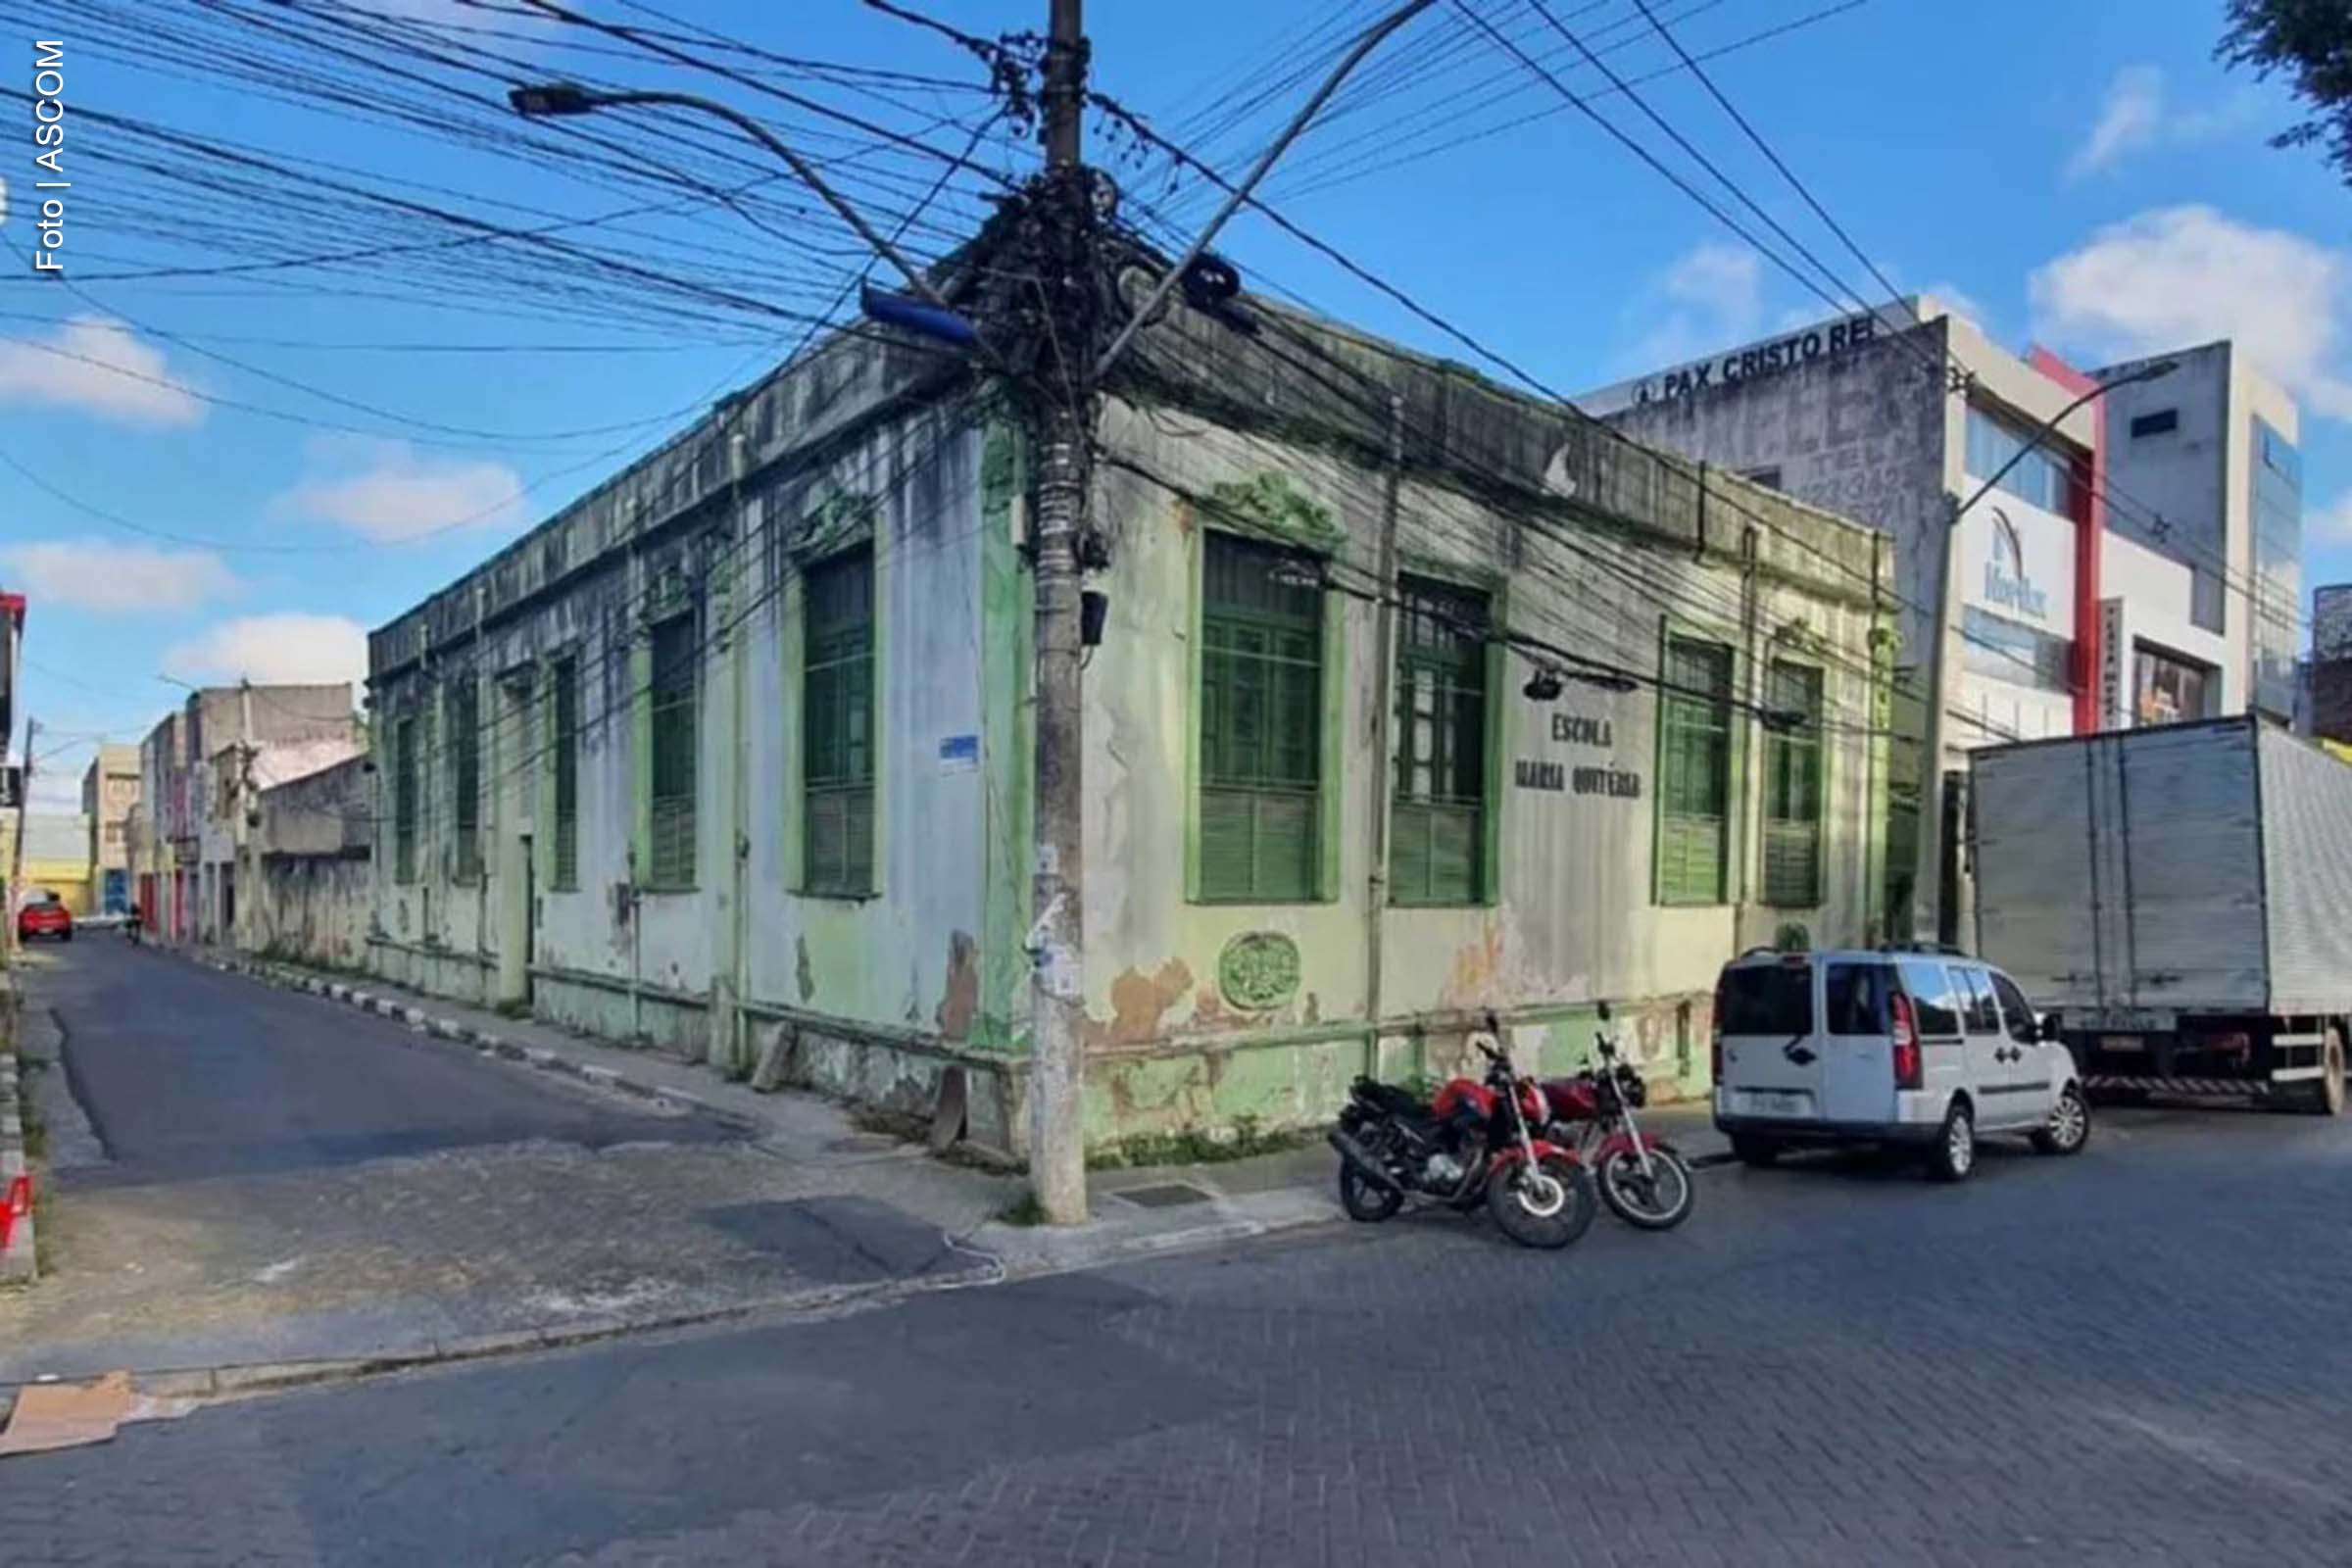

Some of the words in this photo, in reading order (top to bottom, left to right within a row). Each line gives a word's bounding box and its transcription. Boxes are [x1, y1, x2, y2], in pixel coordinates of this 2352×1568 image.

[1664, 362, 1713, 399] PAX
[1722, 332, 1821, 384] CRISTO
[1828, 313, 1874, 354] REI
[1551, 712, 1613, 748] ESCOLA
[1514, 759, 1564, 792] MARIA
